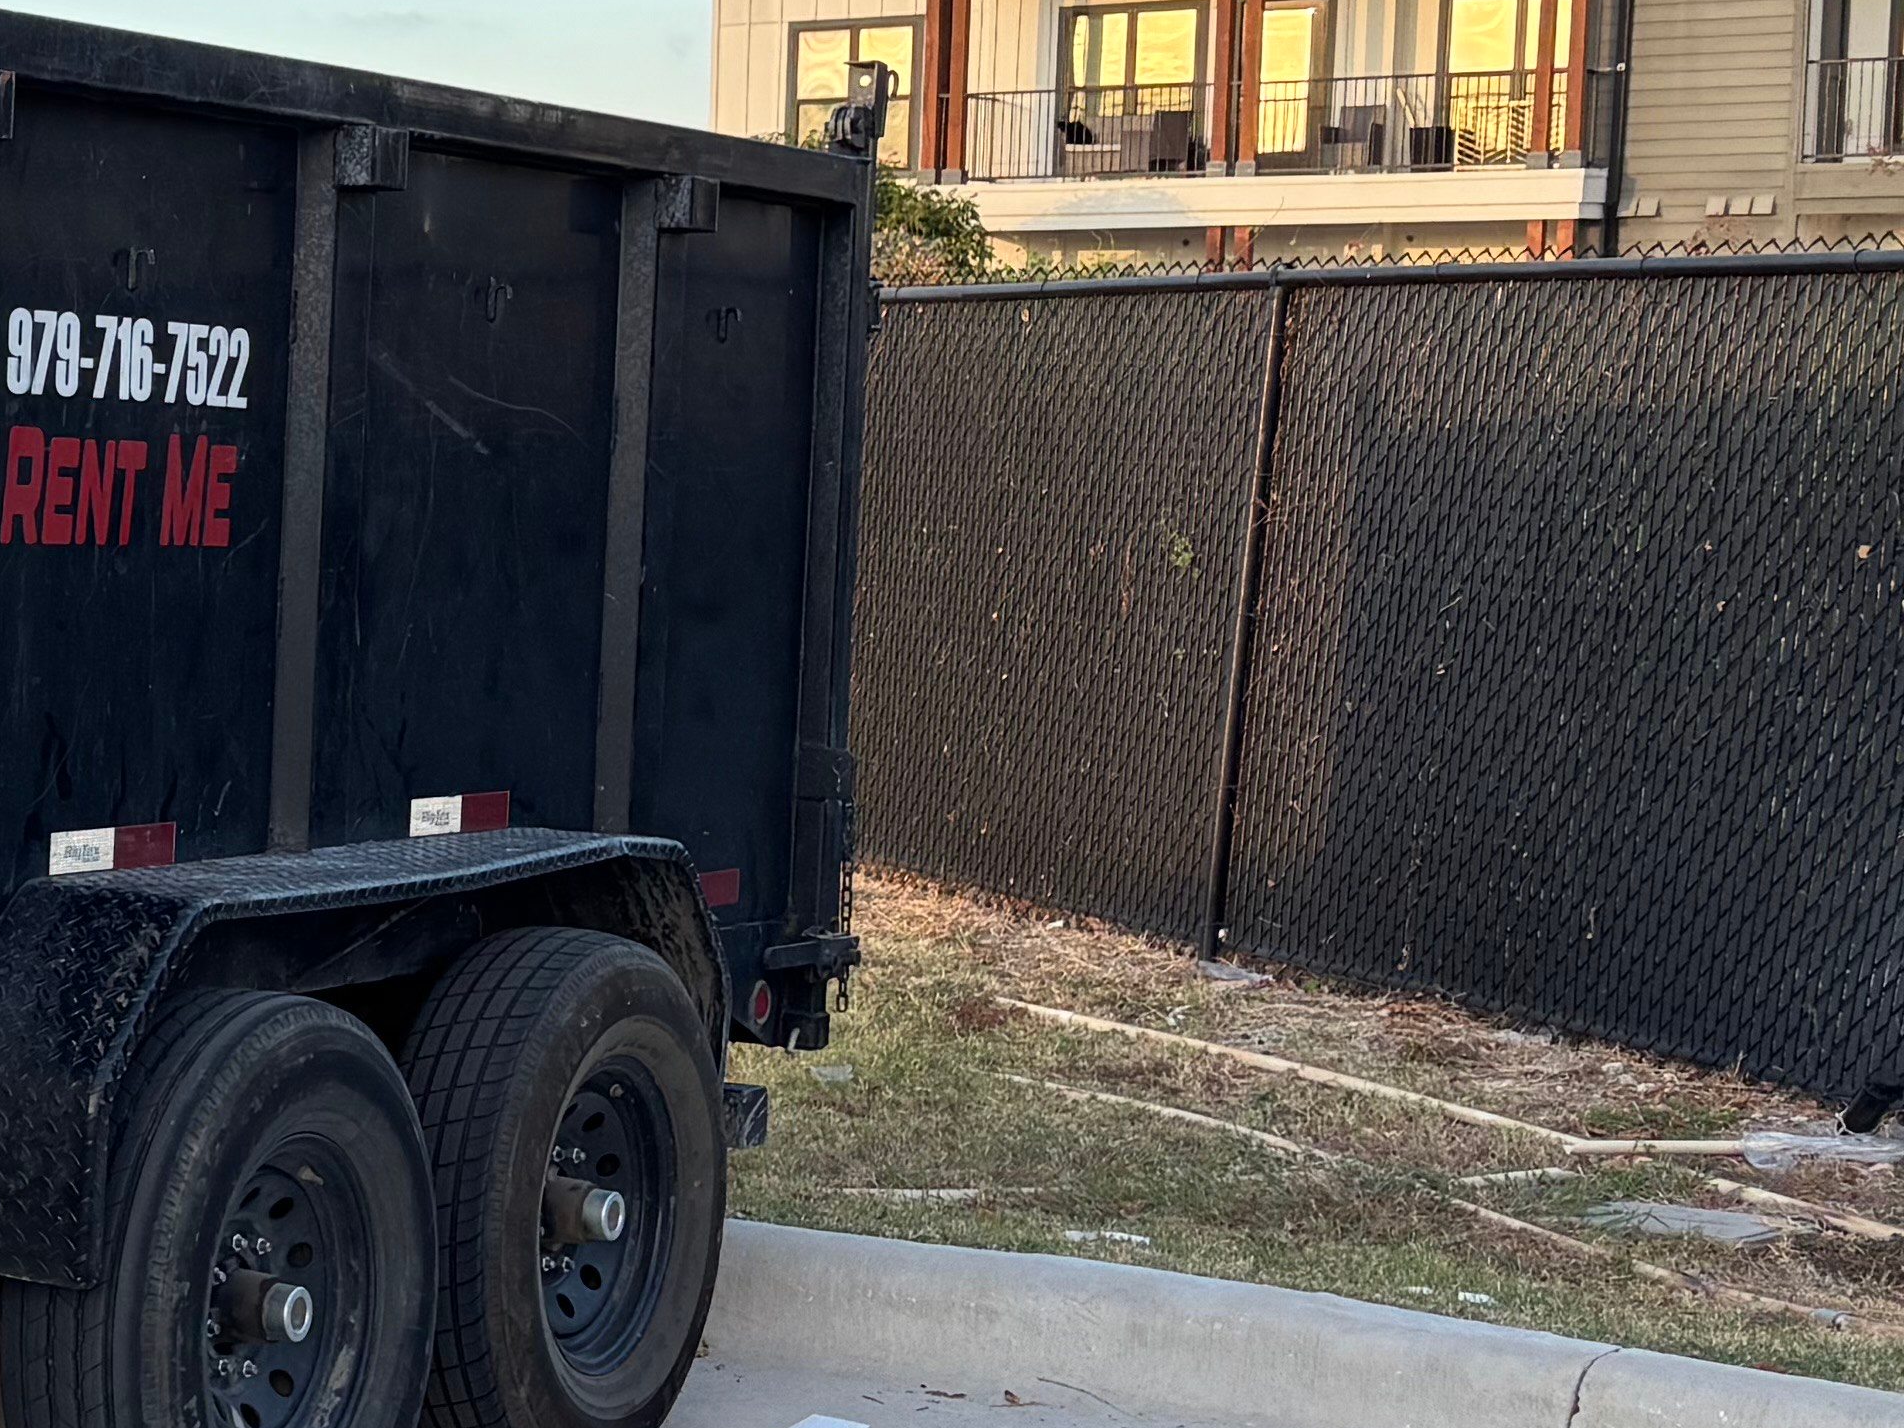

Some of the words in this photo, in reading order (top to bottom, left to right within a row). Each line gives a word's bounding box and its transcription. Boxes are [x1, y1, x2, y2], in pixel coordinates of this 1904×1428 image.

[6, 307, 250, 409] 979-716-7522
[0, 425, 148, 546] RENT
[159, 433, 238, 547] ME
